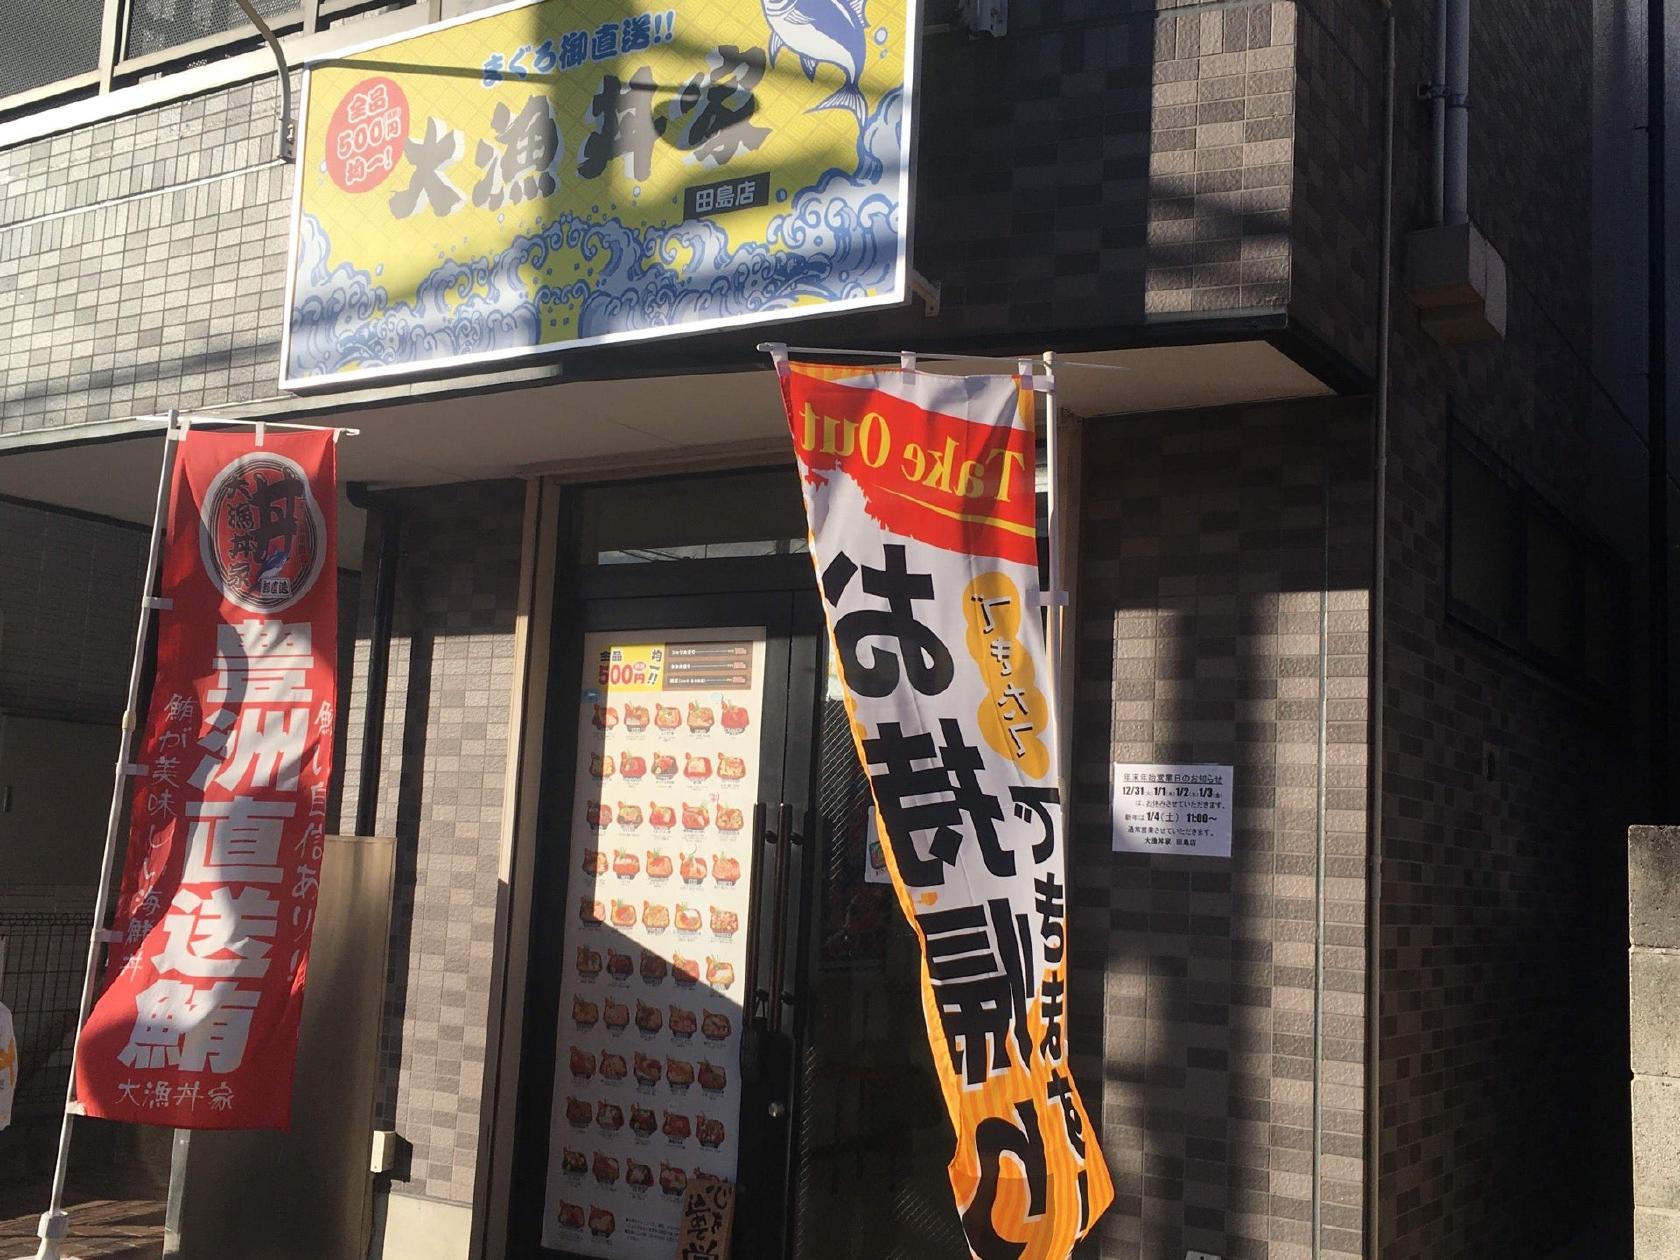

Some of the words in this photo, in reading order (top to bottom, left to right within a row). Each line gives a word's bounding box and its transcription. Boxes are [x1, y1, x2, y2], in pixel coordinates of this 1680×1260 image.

[481, 9, 676, 88] まぐろ御直送!!
[347, 84, 388, 123] 全品
[389, 45, 773, 219] 大漁丼家
[695, 181, 755, 213] 田島店
[599, 663, 645, 685] 500円
[117, 619, 313, 1073] 豊洲直送鮪
[115, 1078, 234, 1110] 大漁丼家
